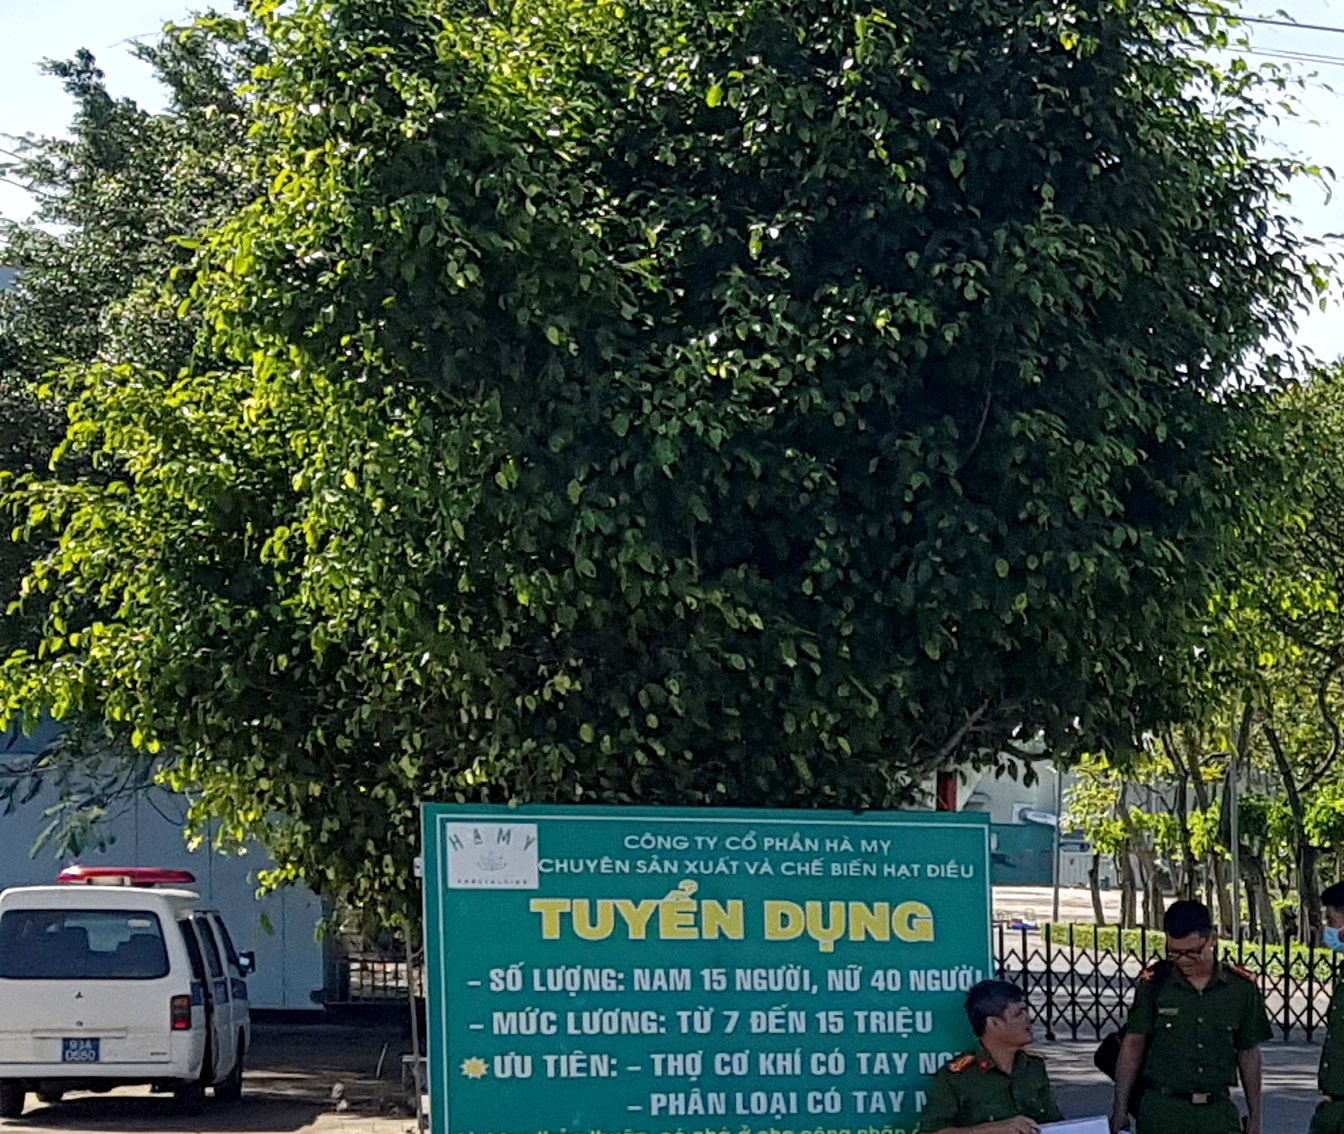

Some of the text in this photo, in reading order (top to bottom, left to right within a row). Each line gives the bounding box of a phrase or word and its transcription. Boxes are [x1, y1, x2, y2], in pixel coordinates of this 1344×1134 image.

[624, 830, 891, 855] CÔNG TY CỔ PHẦN HÀ MY
[539, 855, 974, 880] CHUYÊN SẢN XUẤT VÀ CHẾ BIẾN HẠT ĐIỀU
[530, 879, 934, 953] TUYỂN DỤNG
[490, 962, 525, 991] SỐ
[533, 965, 625, 997] LƯỢNG:
[634, 968, 691, 991] NAM
[700, 968, 727, 991] 15
[735, 964, 818, 994] NGƯỜI,
[828, 965, 863, 991] NỮ
[871, 969, 900, 991] 40
[909, 964, 982, 991] NGƯỜI
[493, 1006, 557, 1035] MỨC
[567, 1008, 666, 1034] LƯƠNG:
[677, 1006, 714, 1034] TỪ
[723, 1011, 740, 1034] 7
[750, 1004, 806, 1034] ĐẾN
[816, 1011, 844, 1034] 15
[854, 1007, 932, 1038] TRIỆU
[494, 1052, 532, 1078] ƯU
[543, 1051, 618, 1077] TIÊN:
[650, 1050, 703, 1081] THỢ
[714, 1050, 750, 1076] CƠ
[759, 1048, 801, 1076] KHÍ
[810, 1048, 845, 1076] CÓ
[856, 1052, 910, 1075] TAY
[651, 1088, 726, 1115] PHÂN
[736, 1092, 797, 1119] LOẠI
[807, 1087, 842, 1114] CÓ
[852, 1091, 905, 1114] TAY
